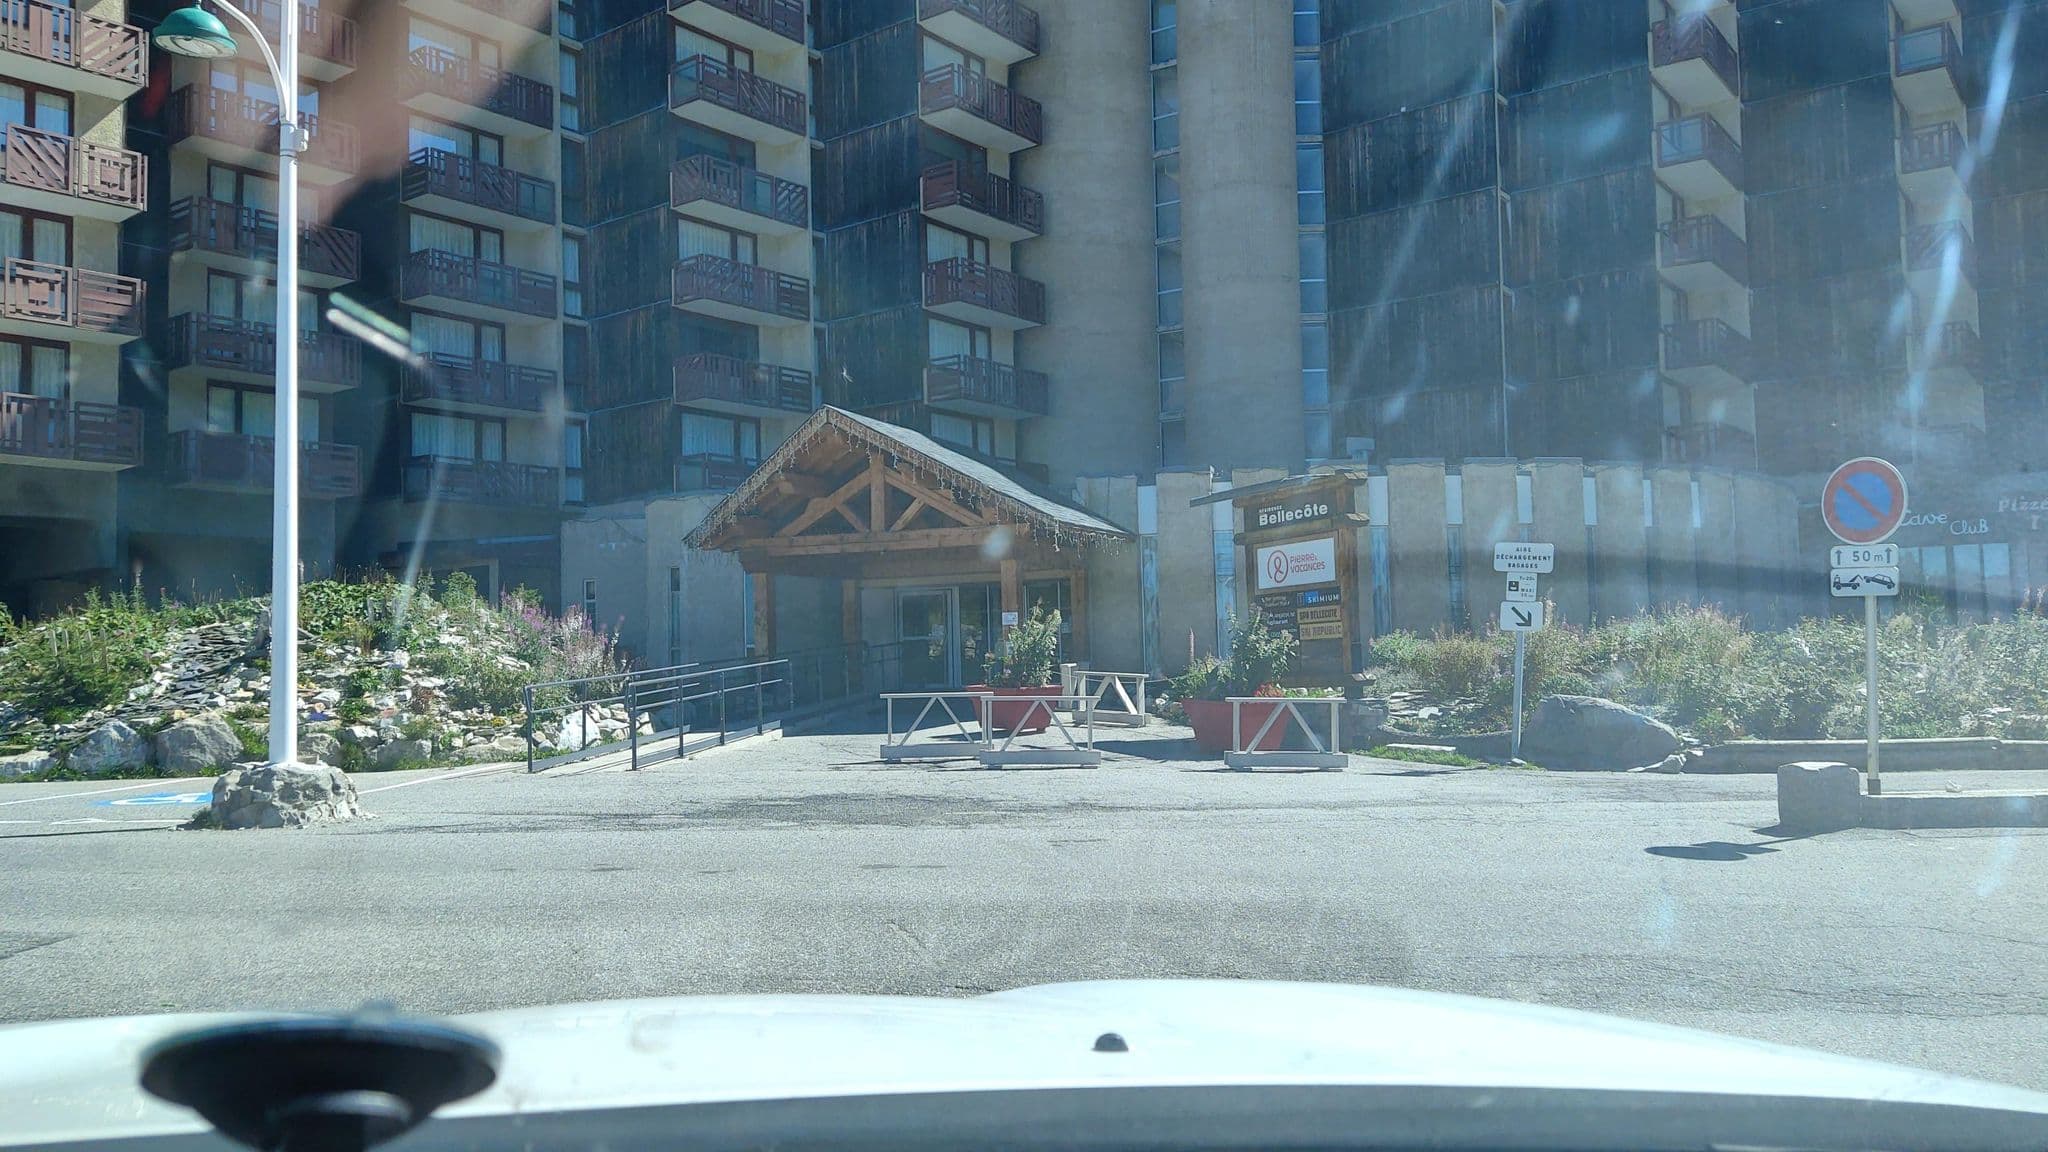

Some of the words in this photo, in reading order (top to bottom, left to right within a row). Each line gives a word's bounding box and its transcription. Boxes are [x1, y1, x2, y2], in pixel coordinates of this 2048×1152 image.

[1259, 503, 1328, 526] Bellecôte
[1898, 510, 1948, 526] Cave
[1495, 553, 1551, 561] DÉCHARGEMENT
[1307, 593, 1340, 603] SKIMIUM
